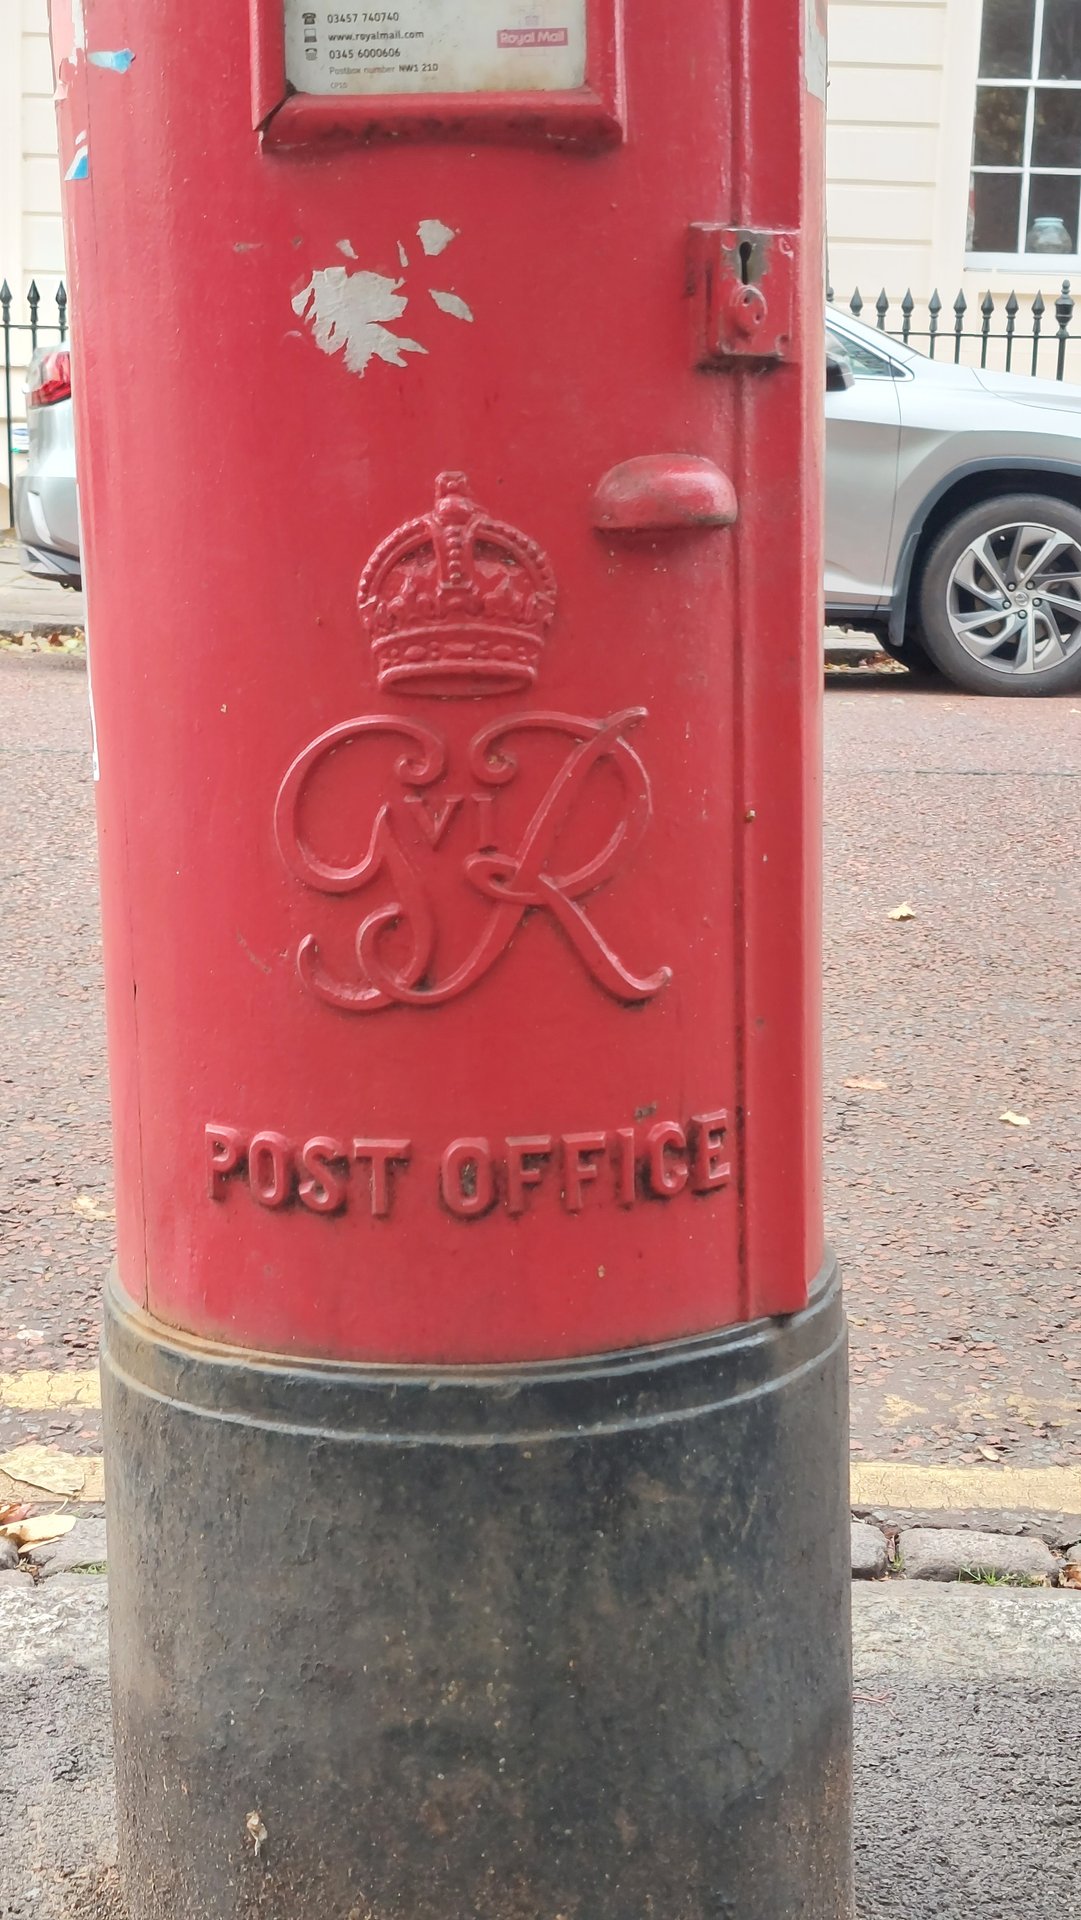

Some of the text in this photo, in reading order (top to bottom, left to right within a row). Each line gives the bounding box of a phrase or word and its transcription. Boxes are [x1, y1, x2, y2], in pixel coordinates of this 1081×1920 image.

[327, 12, 400, 24] 03457 740740
[328, 30, 425, 42] www.royalmail.com
[500, 30, 565, 45] Royal Mail
[329, 48, 401, 60] 0345 6000606
[329, 66, 361, 75] Postbox
[363, 66, 395, 74] number
[399, 64, 419, 73] NW1
[204, 1108, 732, 1216] POST OFFICE
